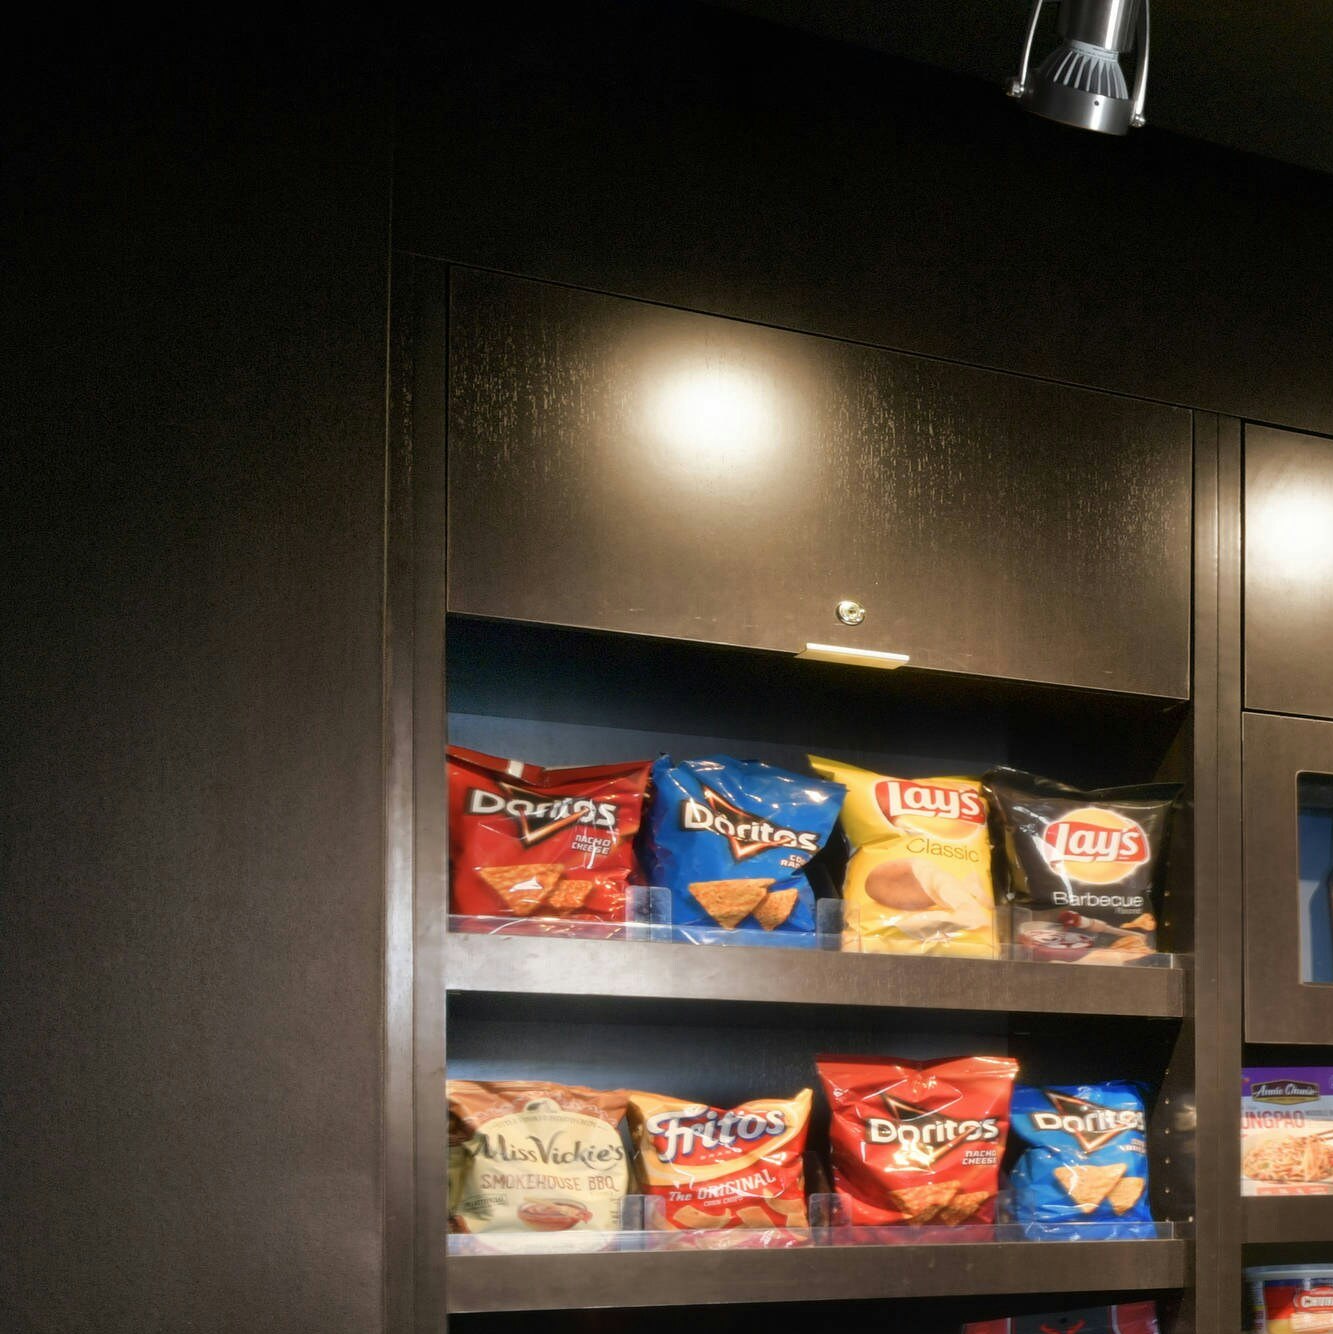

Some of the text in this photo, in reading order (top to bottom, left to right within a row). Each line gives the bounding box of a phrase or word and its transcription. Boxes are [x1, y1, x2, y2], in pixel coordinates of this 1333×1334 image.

[470, 789, 616, 827] Doritos
[888, 780, 984, 820] Lay's
[683, 801, 818, 851] Doritos
[572, 841, 611, 855] CHEESE
[576, 834, 611, 847] NACHO
[905, 838, 980, 863] Classic
[1053, 822, 1147, 863] Lay's
[1052, 891, 1144, 908] Barbecue
[646, 1104, 786, 1162] Fritos
[867, 1117, 999, 1144] Doritos
[1033, 1111, 1146, 1133] Doritos
[469, 1129, 625, 1171] Miss Vickie's
[961, 1157, 998, 1166] CHEESE
[964, 1149, 997, 1158] NACHO
[480, 1173, 620, 1192] SMOKEHOUSE BBQ
[668, 1168, 777, 1202] The ORIGINAL
